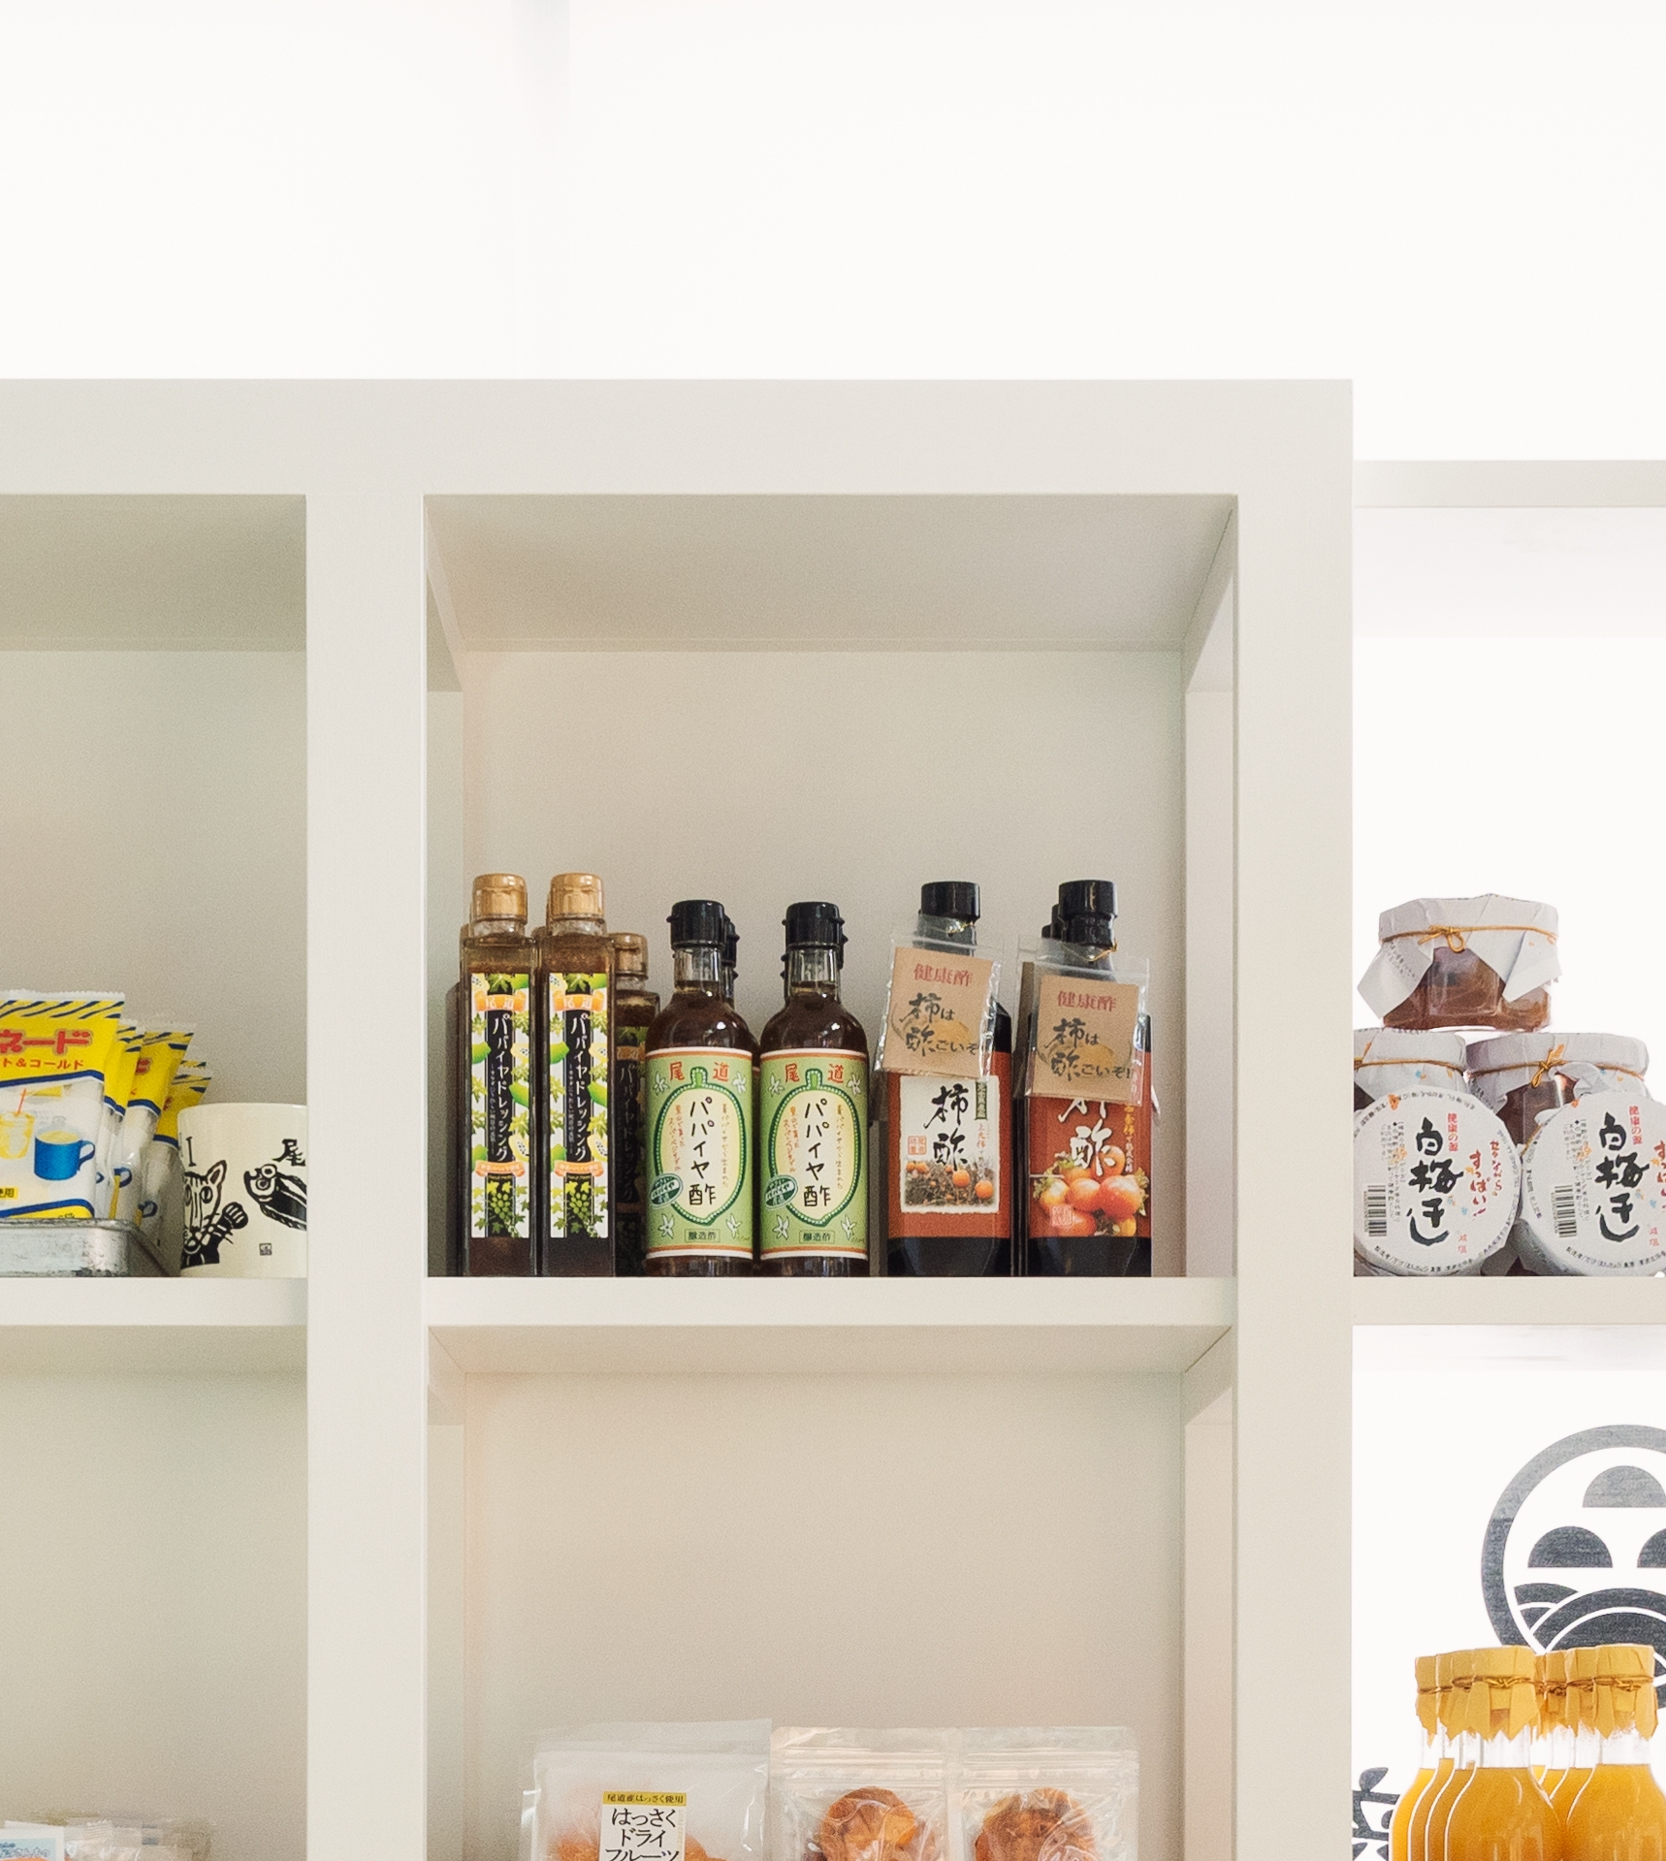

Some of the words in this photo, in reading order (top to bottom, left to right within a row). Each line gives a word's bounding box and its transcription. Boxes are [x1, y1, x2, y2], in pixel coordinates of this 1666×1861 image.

[913, 963, 973, 987] 健康酢
[900, 993, 955, 1024] 柿は
[1057, 990, 1117, 1012] 健康酢
[1044, 1017, 1099, 1049] 柿は
[492, 1013, 511, 1162] パパイヤドレッシング
[570, 1013, 590, 1162] パパイヤドレッシング
[669, 1061, 729, 1082] 尾道
[785, 1063, 844, 1083] 尾道
[924, 1083, 969, 1172] 柿酢
[1448, 1113, 1459, 1152] 健康の源
[1629, 1106, 1643, 1145] 健康の源
[689, 1096, 716, 1206] パパイヤ酢
[803, 1098, 831, 1207] パパイヤ酢
[1407, 1117, 1464, 1246] 白梅干し
[1594, 1112, 1650, 1242] 白梅干し
[606, 1793, 684, 1804] 尾道産はっさく使用
[611, 1808, 677, 1828] はっさく
[619, 1829, 667, 1848] ドライ
